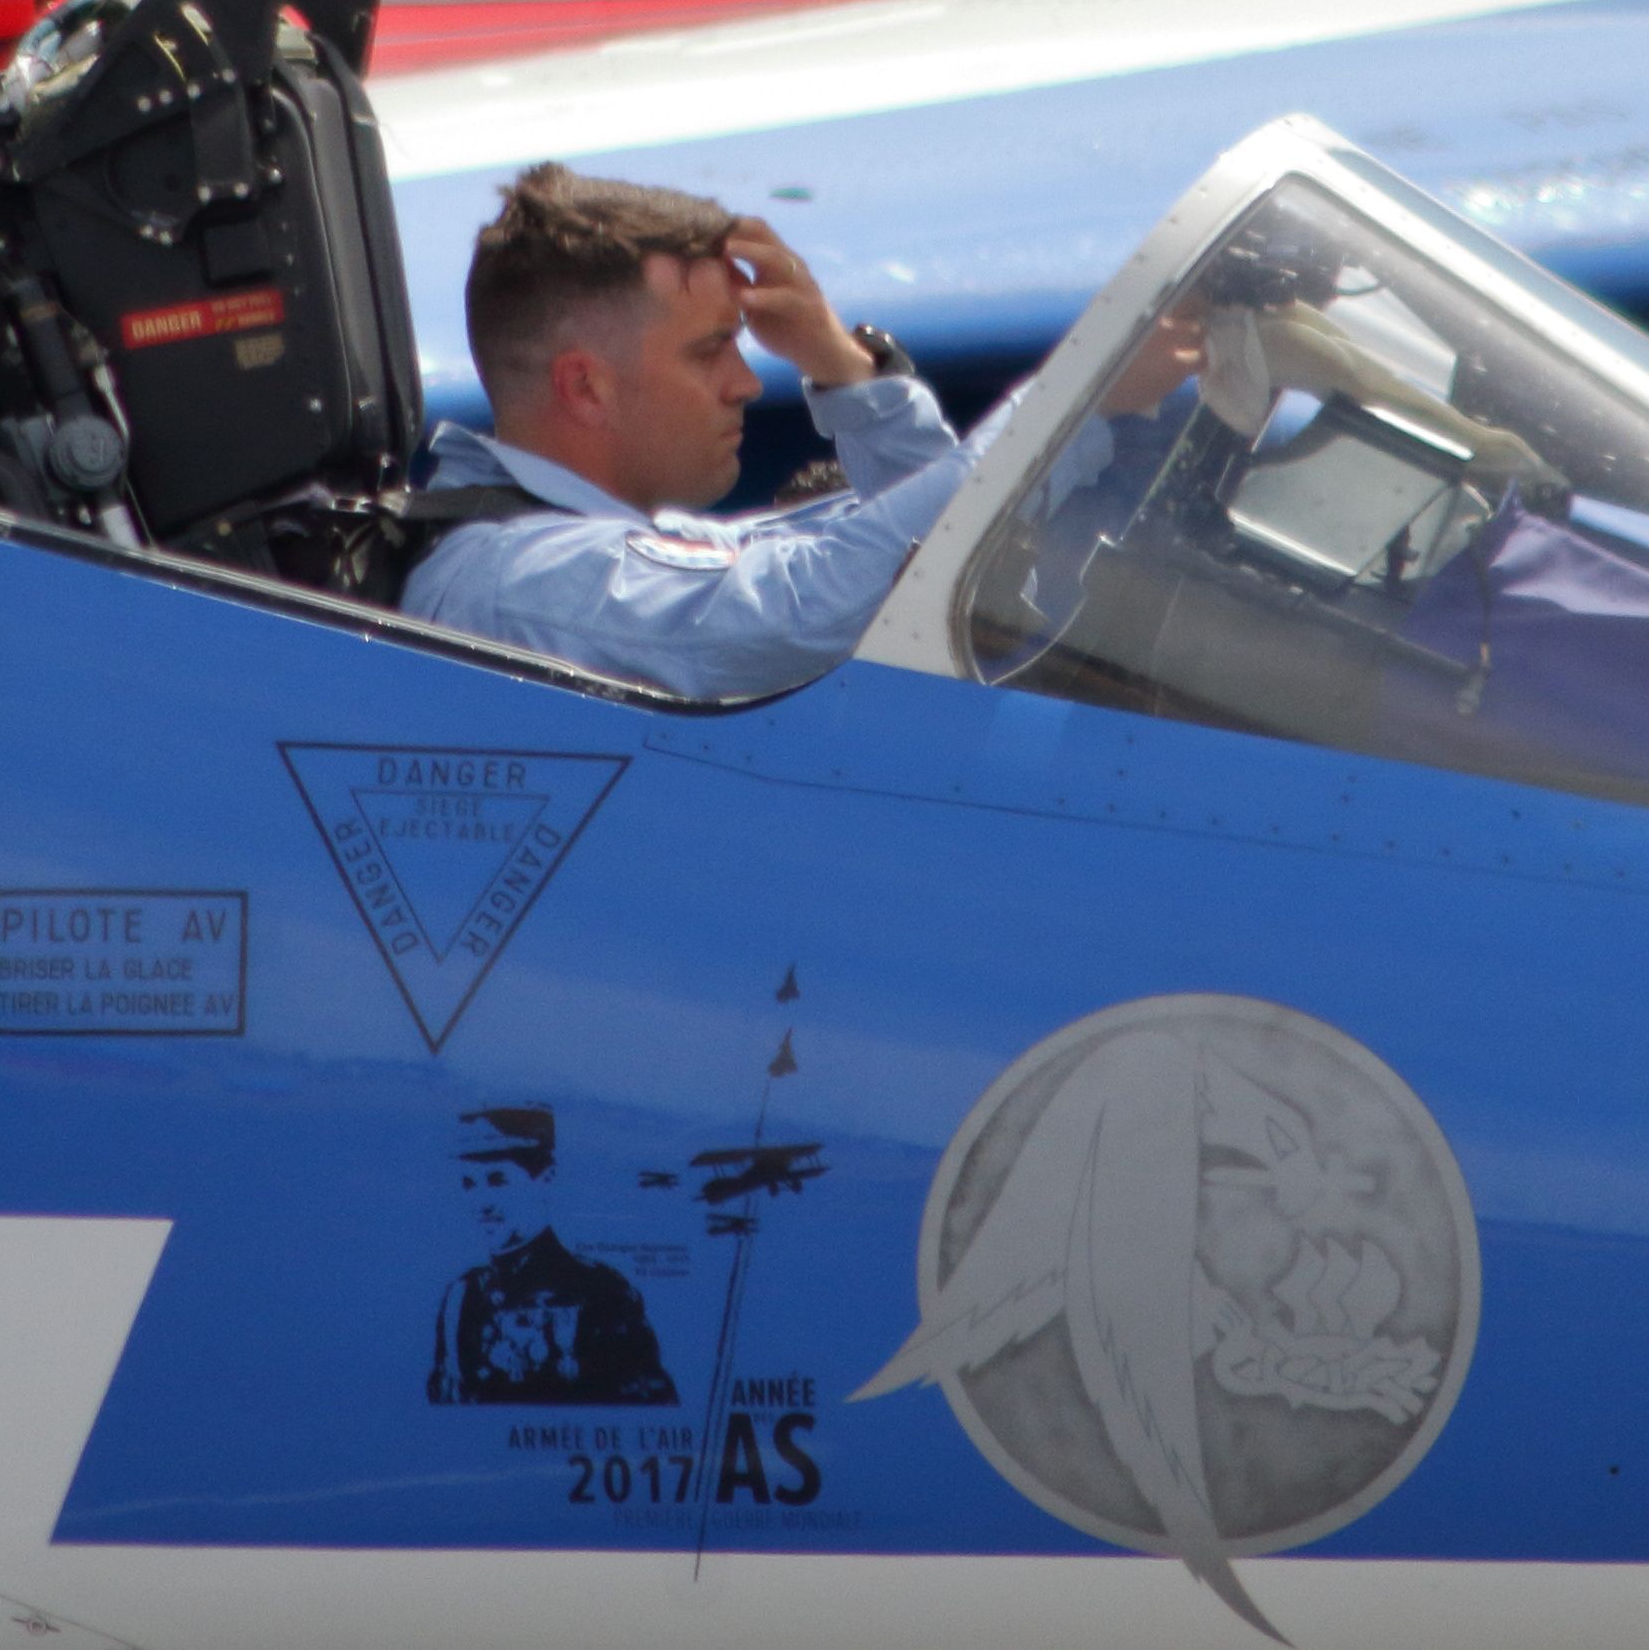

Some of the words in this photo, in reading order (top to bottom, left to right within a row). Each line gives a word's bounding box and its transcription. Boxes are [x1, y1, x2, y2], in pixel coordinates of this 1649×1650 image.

[131, 310, 201, 341] DANGER
[378, 757, 527, 790] DANGER
[379, 819, 515, 842] EJECTABLE
[334, 820, 421, 956] DANGER
[459, 823, 564, 958] DANGER
[3, 908, 143, 943] PILOTE
[181, 909, 227, 942] AV
[0, 957, 75, 981] BRISER
[84, 958, 112, 981] LA
[123, 958, 193, 982] GLACE
[0, 992, 59, 1015] TIRER
[66, 993, 94, 1015] LA
[102, 993, 195, 1016] POIGNEE
[203, 994, 233, 1016] AV
[731, 1370, 816, 1408] ANNÉE
[508, 1421, 590, 1449] ARMÉE
[595, 1426, 623, 1449] DE
[639, 1425, 694, 1449] L'AIR
[716, 1412, 822, 1506] AS
[567, 1456, 696, 1504] 2017
